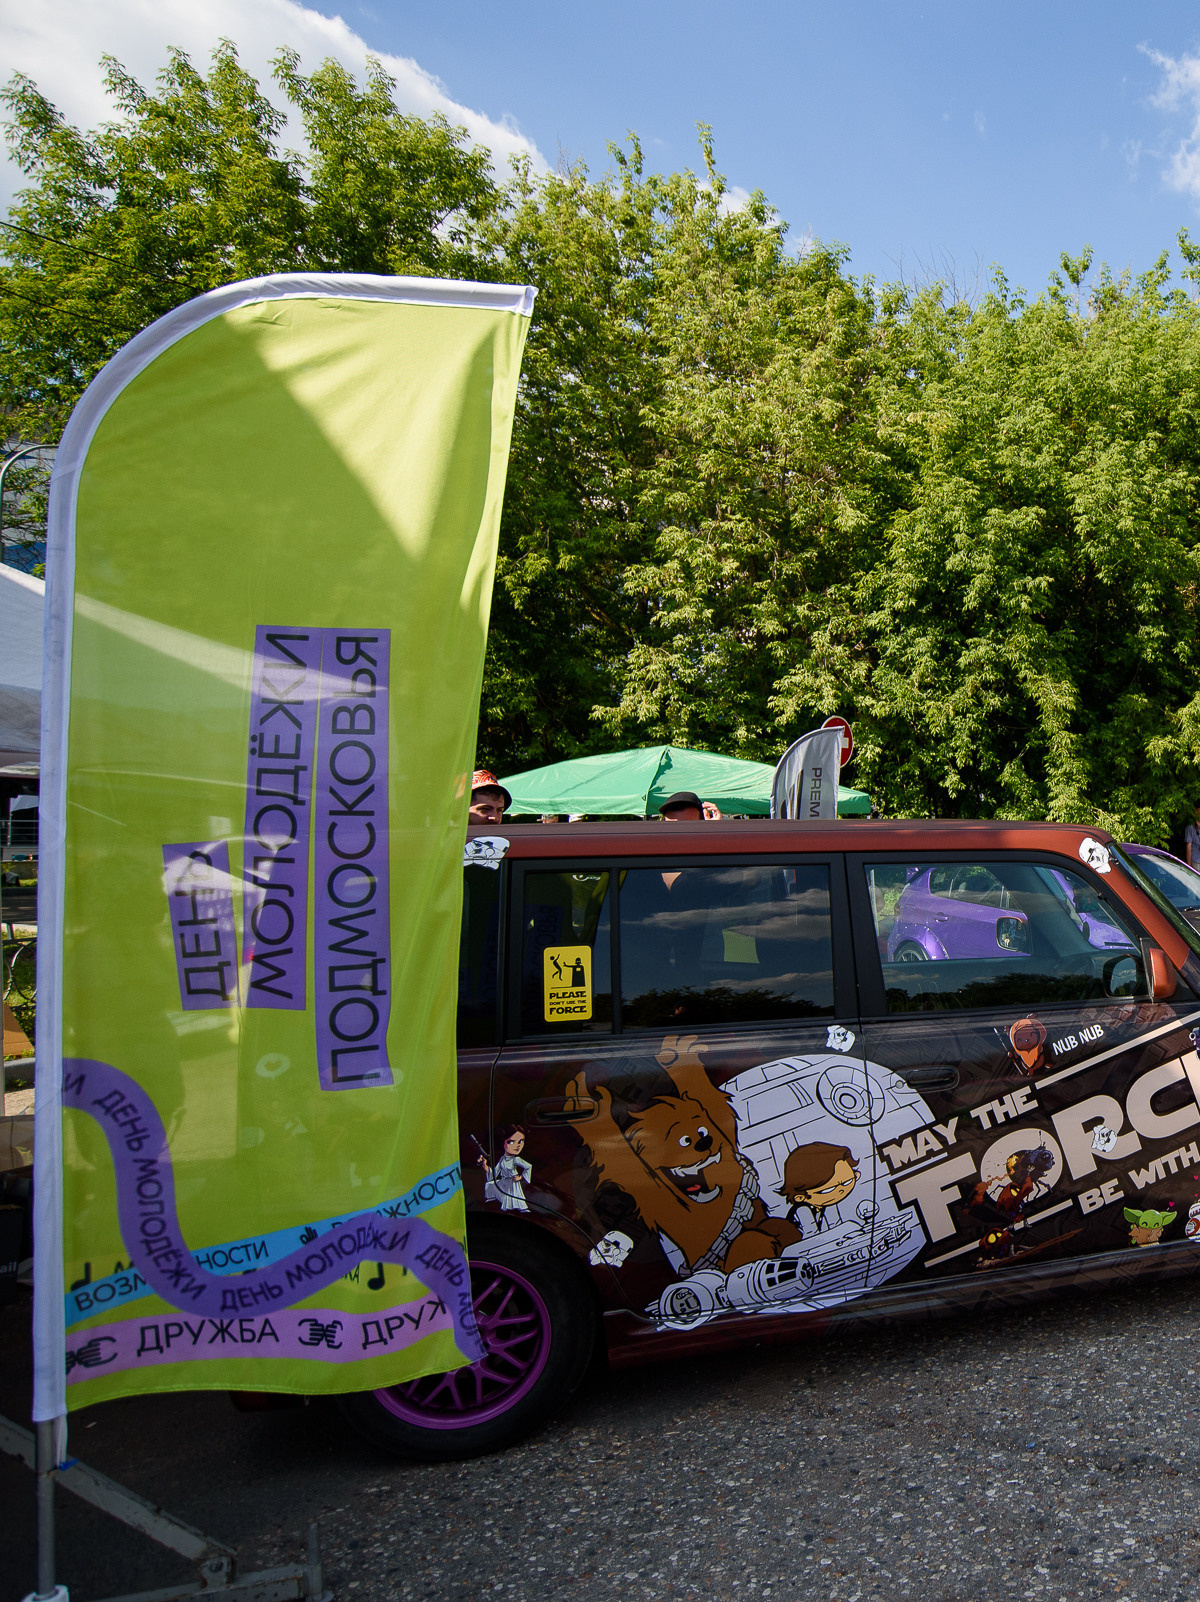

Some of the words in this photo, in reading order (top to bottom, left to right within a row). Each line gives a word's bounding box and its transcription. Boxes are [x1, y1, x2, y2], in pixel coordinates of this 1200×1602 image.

[250, 633, 310, 1000] МОЛОДЁЖИ
[327, 635, 388, 1083] ПОДМОСКОВЬЯ
[175, 850, 231, 1001] ДЕНЬ
[549, 990, 587, 999] PLEASE
[549, 1005, 587, 1015] FORCE
[1052, 1035, 1078, 1056] NUB
[1078, 1024, 1104, 1045] NUB
[881, 1117, 960, 1170] MAY
[970, 1086, 1039, 1131] THE
[92, 1090, 150, 1153] ДЕНЬ
[219, 1281, 284, 1312] ДЕНЬ
[415, 1243, 467, 1287] ДЕНЬ
[1078, 1179, 1125, 1215] BE
[1132, 1140, 1200, 1192] WITH
[136, 1317, 280, 1357] ДРУЖБА
